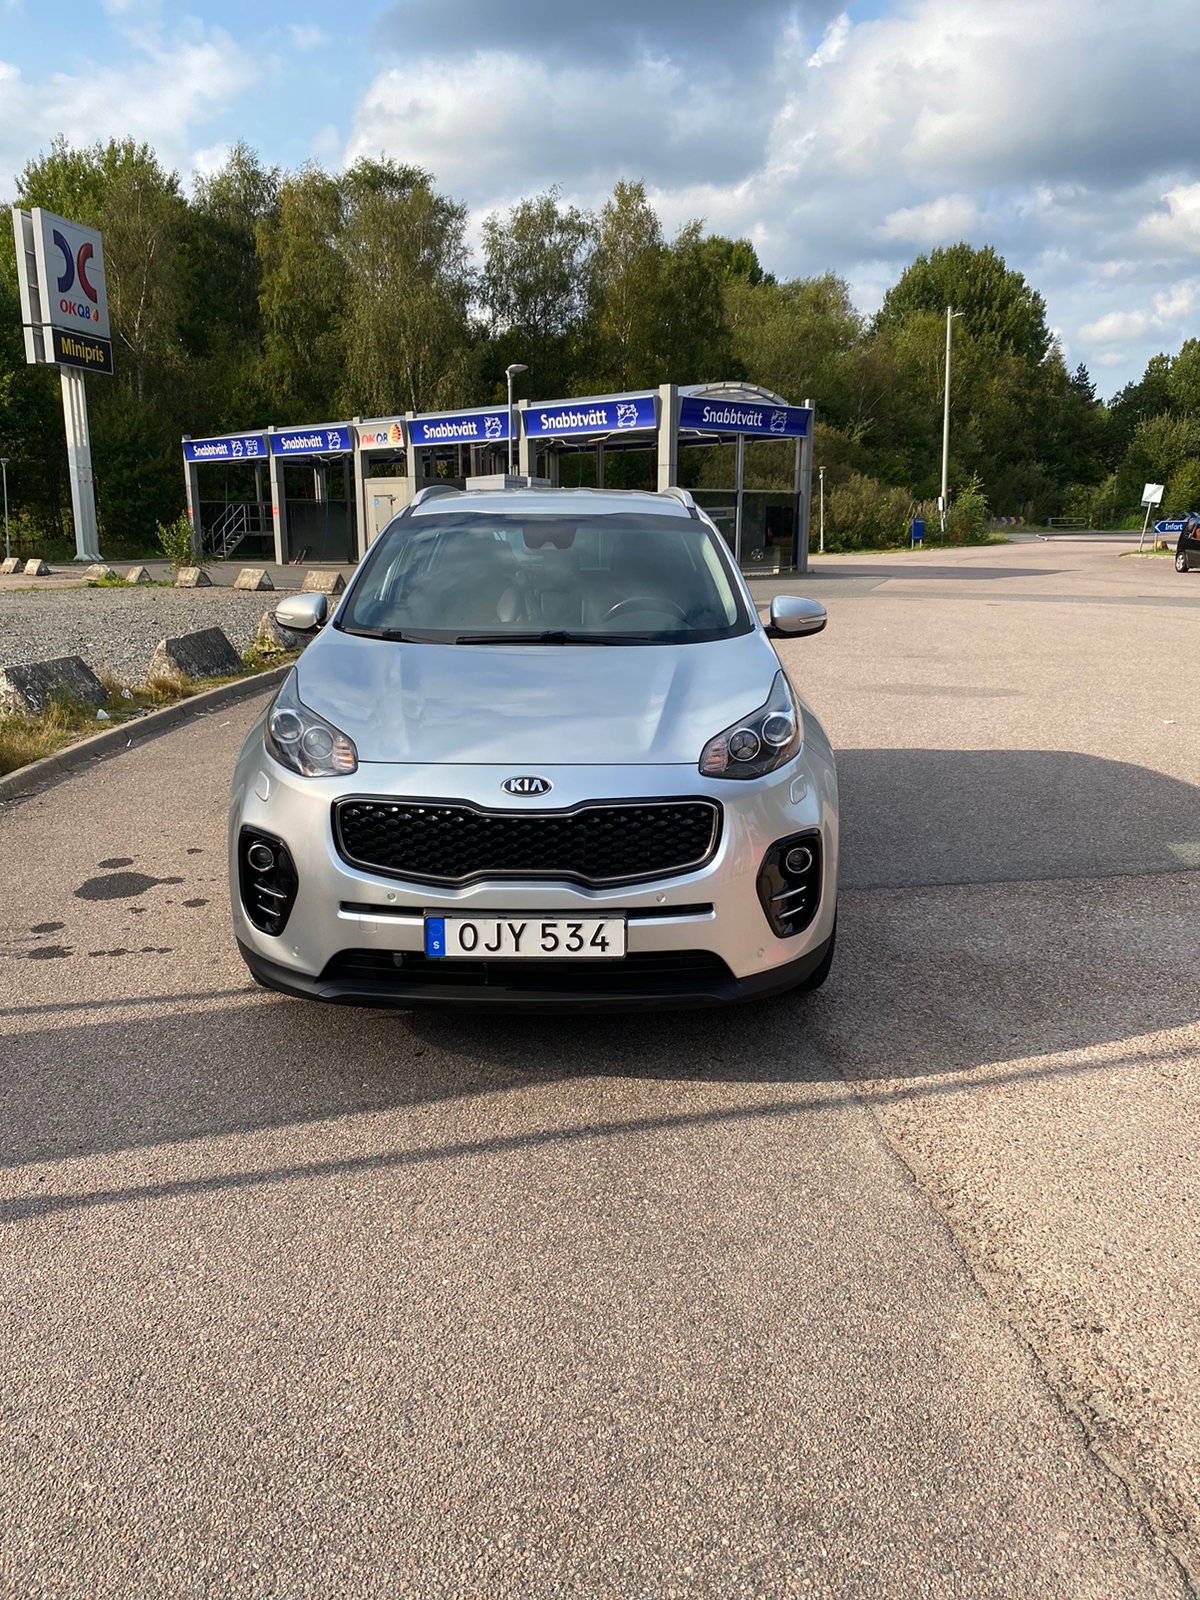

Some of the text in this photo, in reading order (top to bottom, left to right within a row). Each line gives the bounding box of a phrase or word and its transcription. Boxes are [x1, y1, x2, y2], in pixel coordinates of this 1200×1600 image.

[59, 299, 91, 320] OKQ8
[60, 336, 105, 363] Minipris
[540, 408, 607, 430] Snabbtvätt
[702, 406, 763, 427] Snabbtvätt
[423, 420, 478, 439] Snabbtvätt
[193, 443, 229, 457] Snabbtvätt
[281, 435, 323, 450] Snabbtvätt
[510, 779, 544, 792] KIA
[433, 940, 440, 950] S
[458, 922, 610, 952] OJY 534
